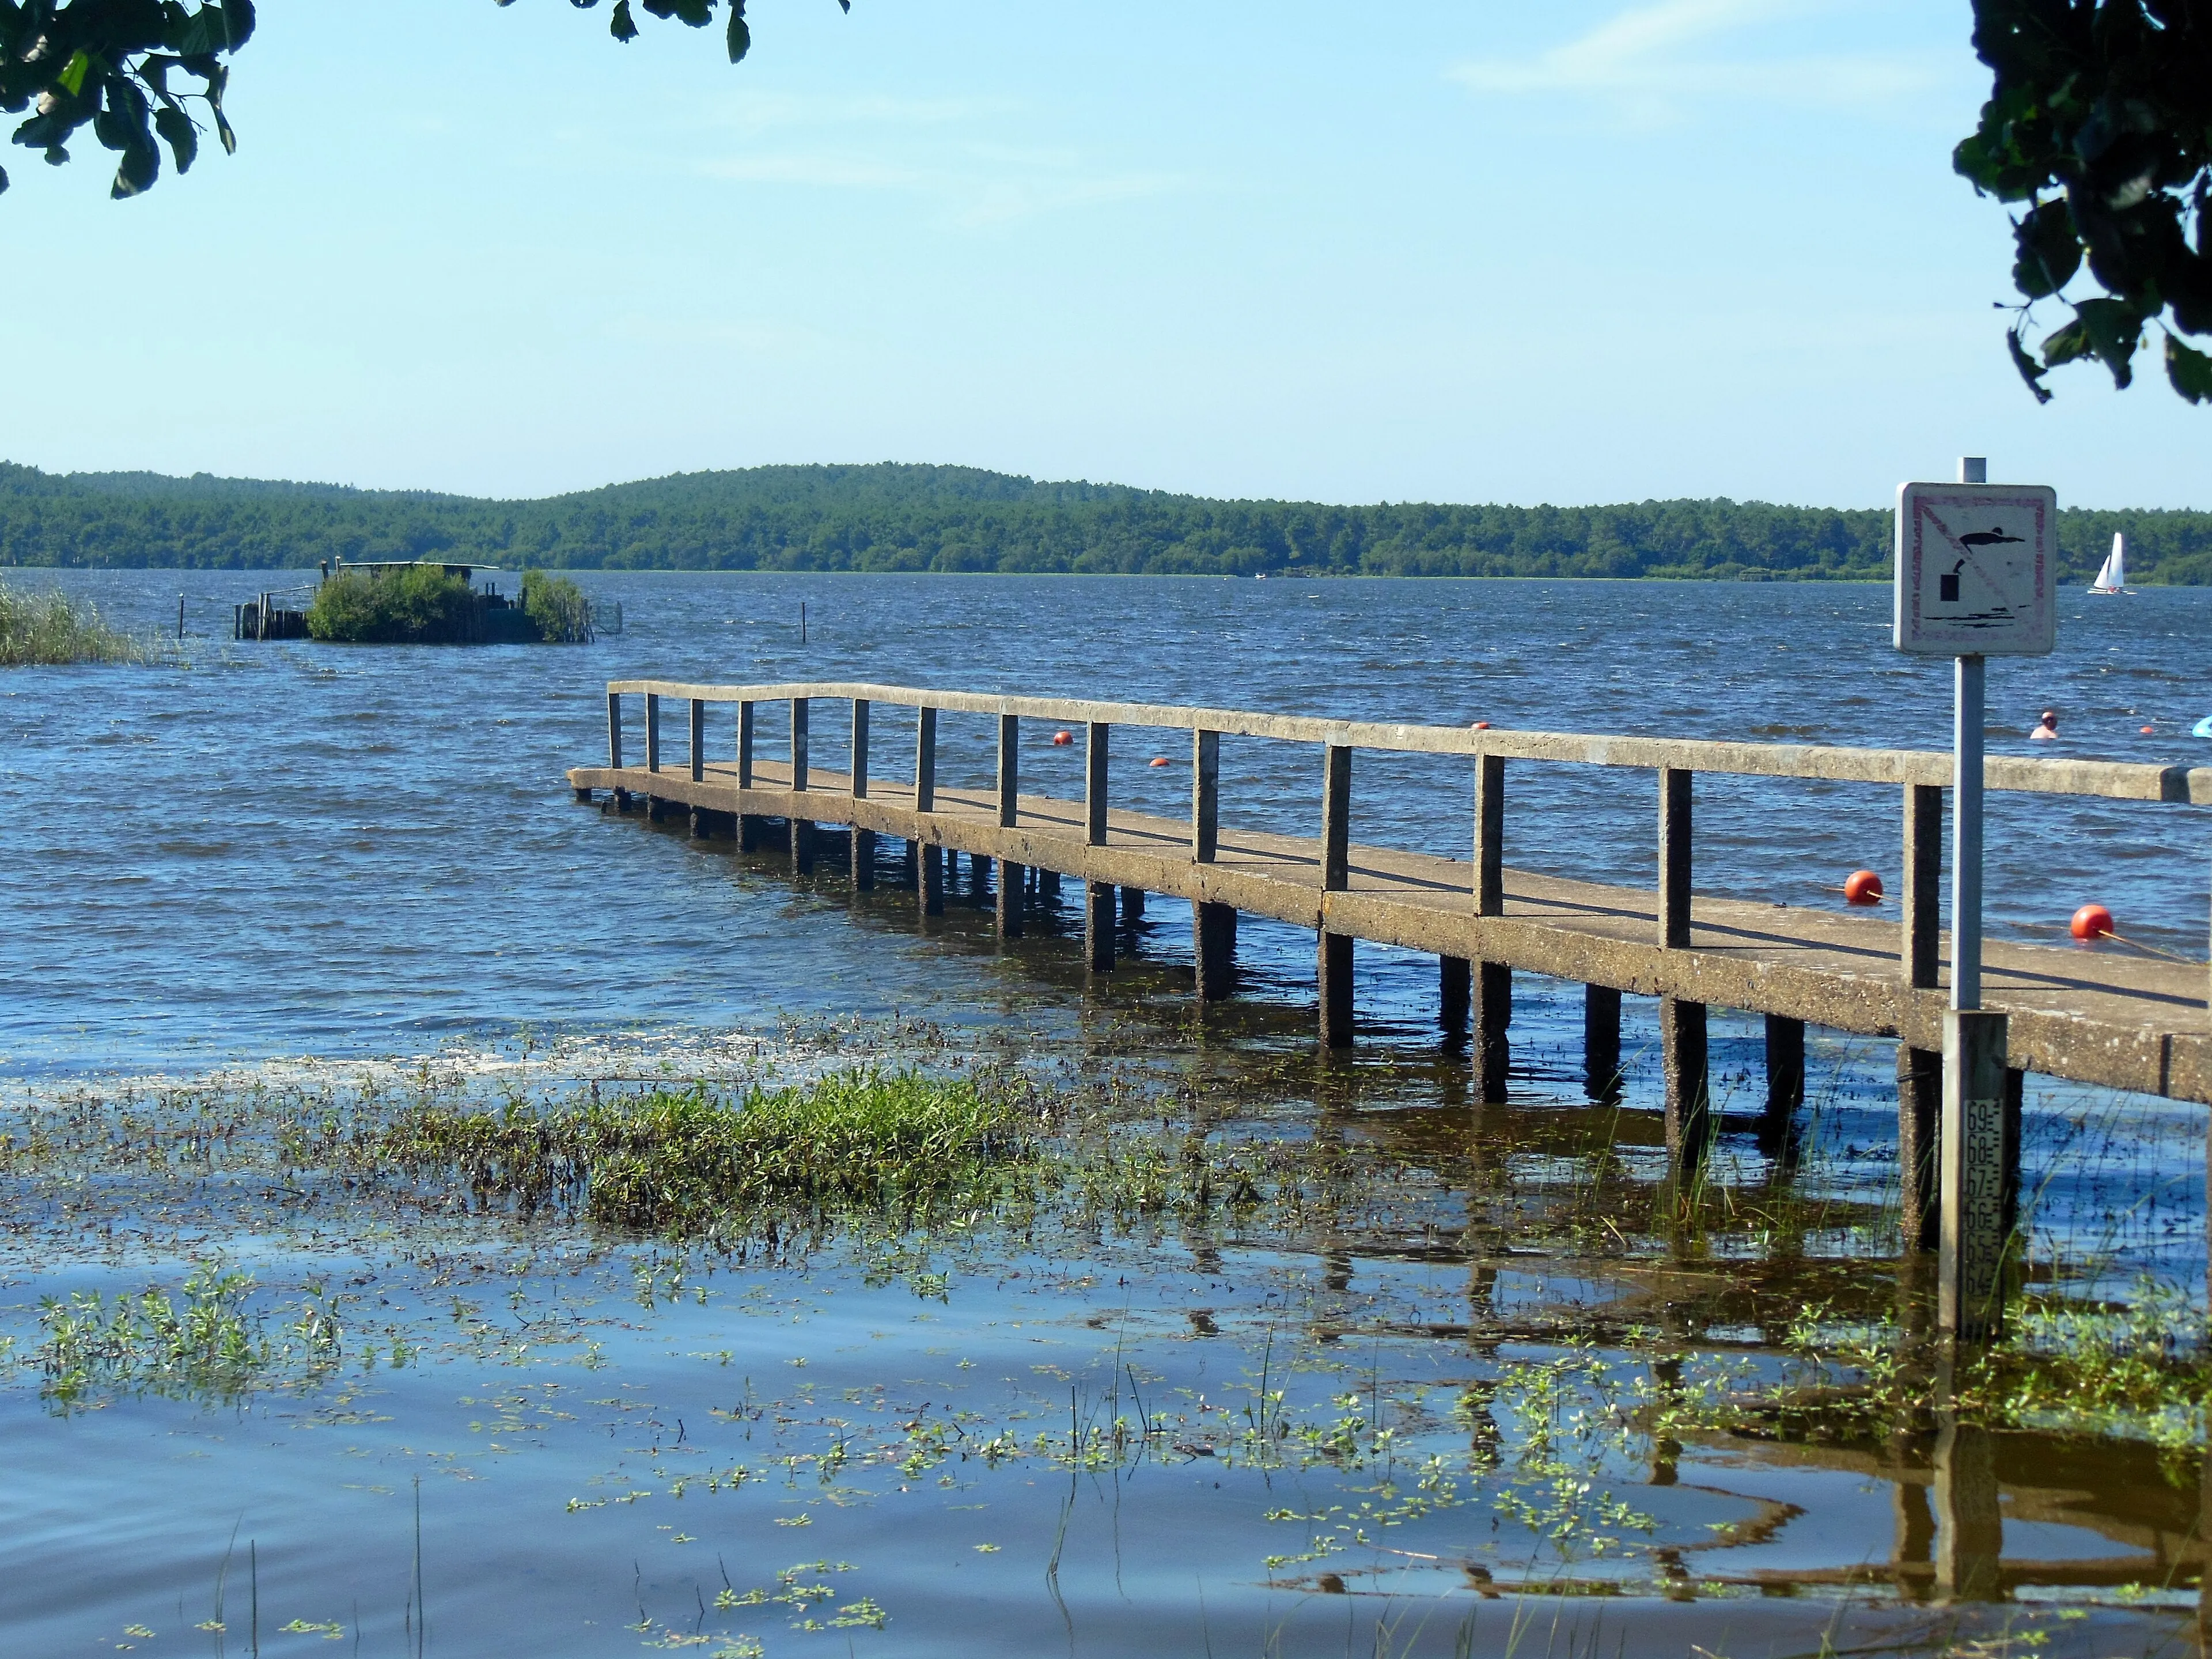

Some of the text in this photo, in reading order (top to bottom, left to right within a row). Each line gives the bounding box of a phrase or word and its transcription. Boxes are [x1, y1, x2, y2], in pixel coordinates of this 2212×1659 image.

[1968, 1101, 1987, 1130] 69
[1968, 1134, 1986, 1163] 68
[1968, 1166, 1986, 1196] 67
[1967, 1199, 1986, 1229] 66
[1967, 1233, 1985, 1261] 65
[1967, 1264, 1986, 1295] 64
